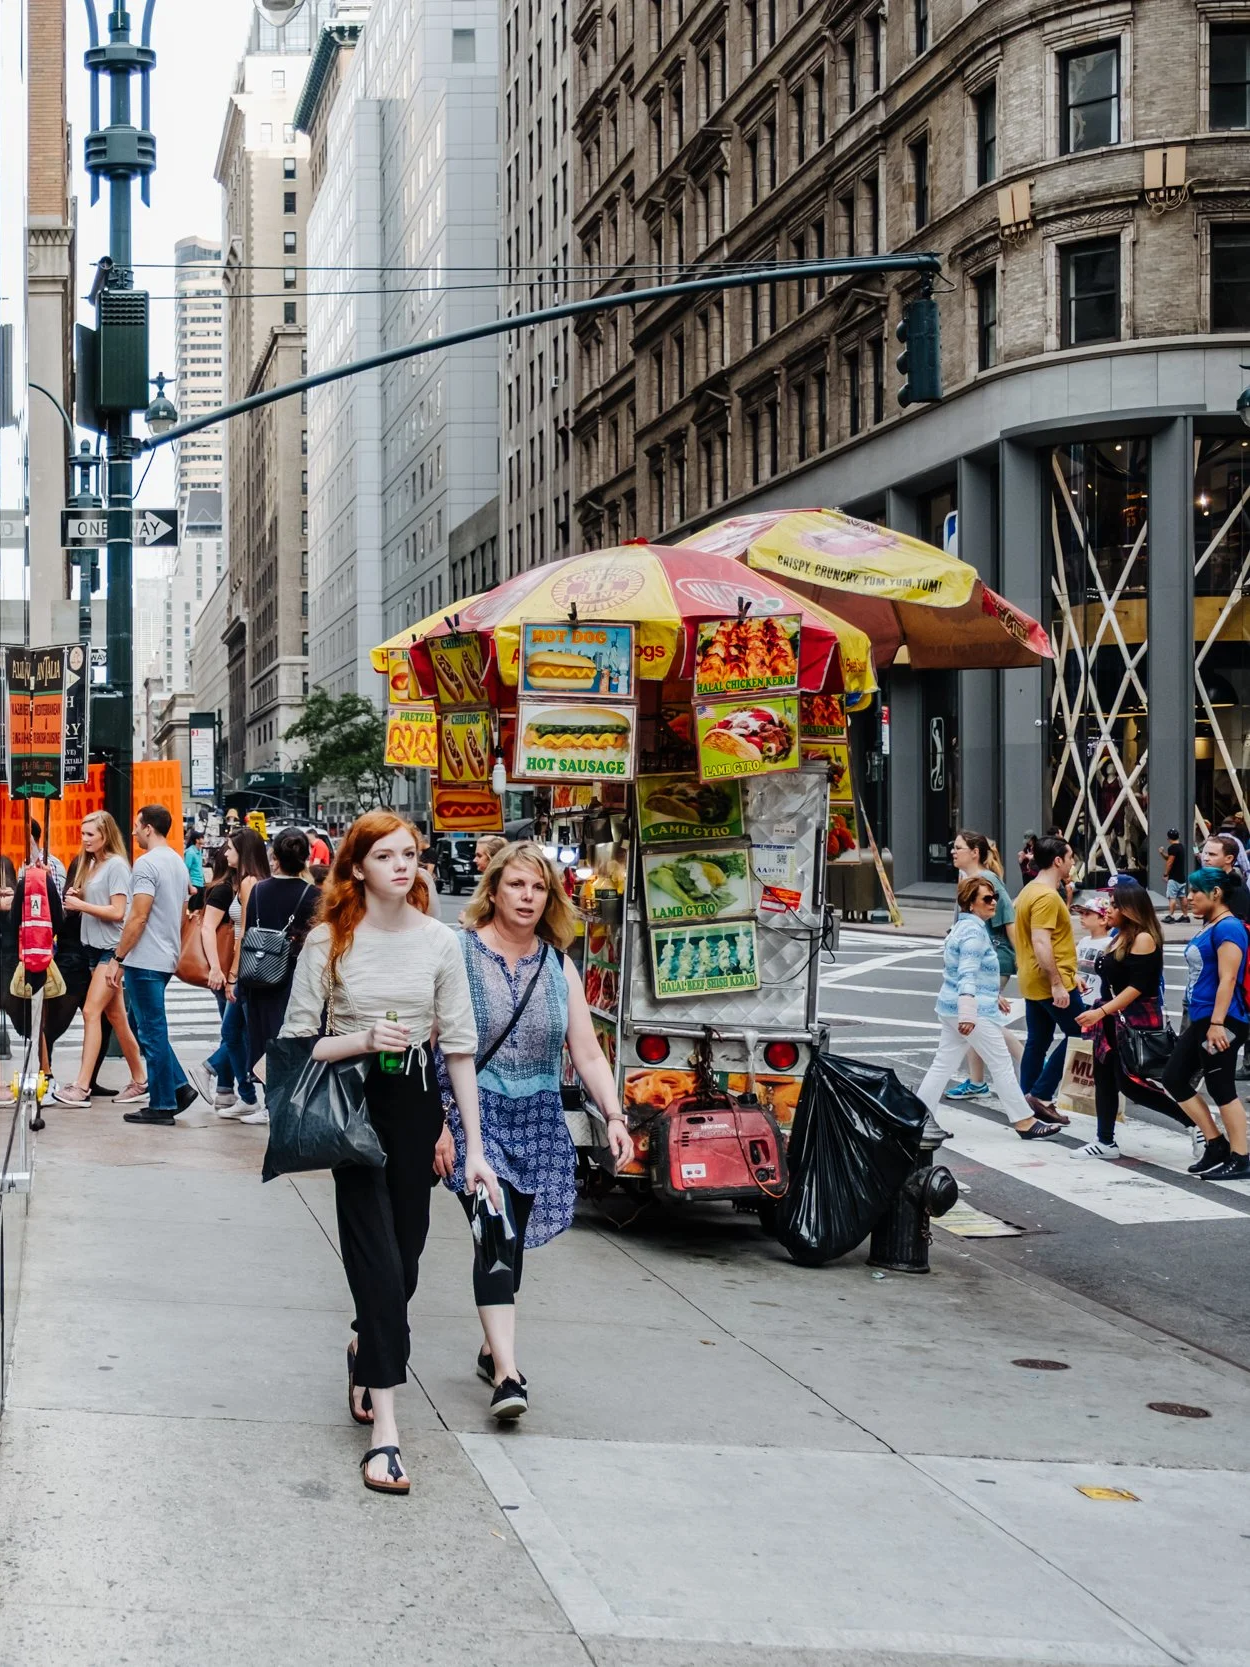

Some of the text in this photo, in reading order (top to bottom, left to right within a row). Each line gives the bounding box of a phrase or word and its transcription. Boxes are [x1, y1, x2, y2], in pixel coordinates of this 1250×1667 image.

[77, 521, 161, 536] ONE AY
[531, 630, 607, 645] HOT DOG
[636, 643, 665, 662] ogs
[697, 675, 796, 694] HALAL CHICKEN KEBAB
[400, 711, 433, 722] PRETZEL
[467, 711, 480, 724] DOG
[526, 757, 625, 775] HOT SAUSAGE
[705, 760, 761, 778] LAMB GYRO
[650, 825, 730, 837] LAMB GYRO
[652, 903, 716, 919] LAMB GYRO
[661, 973, 756, 994] HALAL BEEF SHISH KEBAB
[1071, 1059, 1094, 1079] MU
